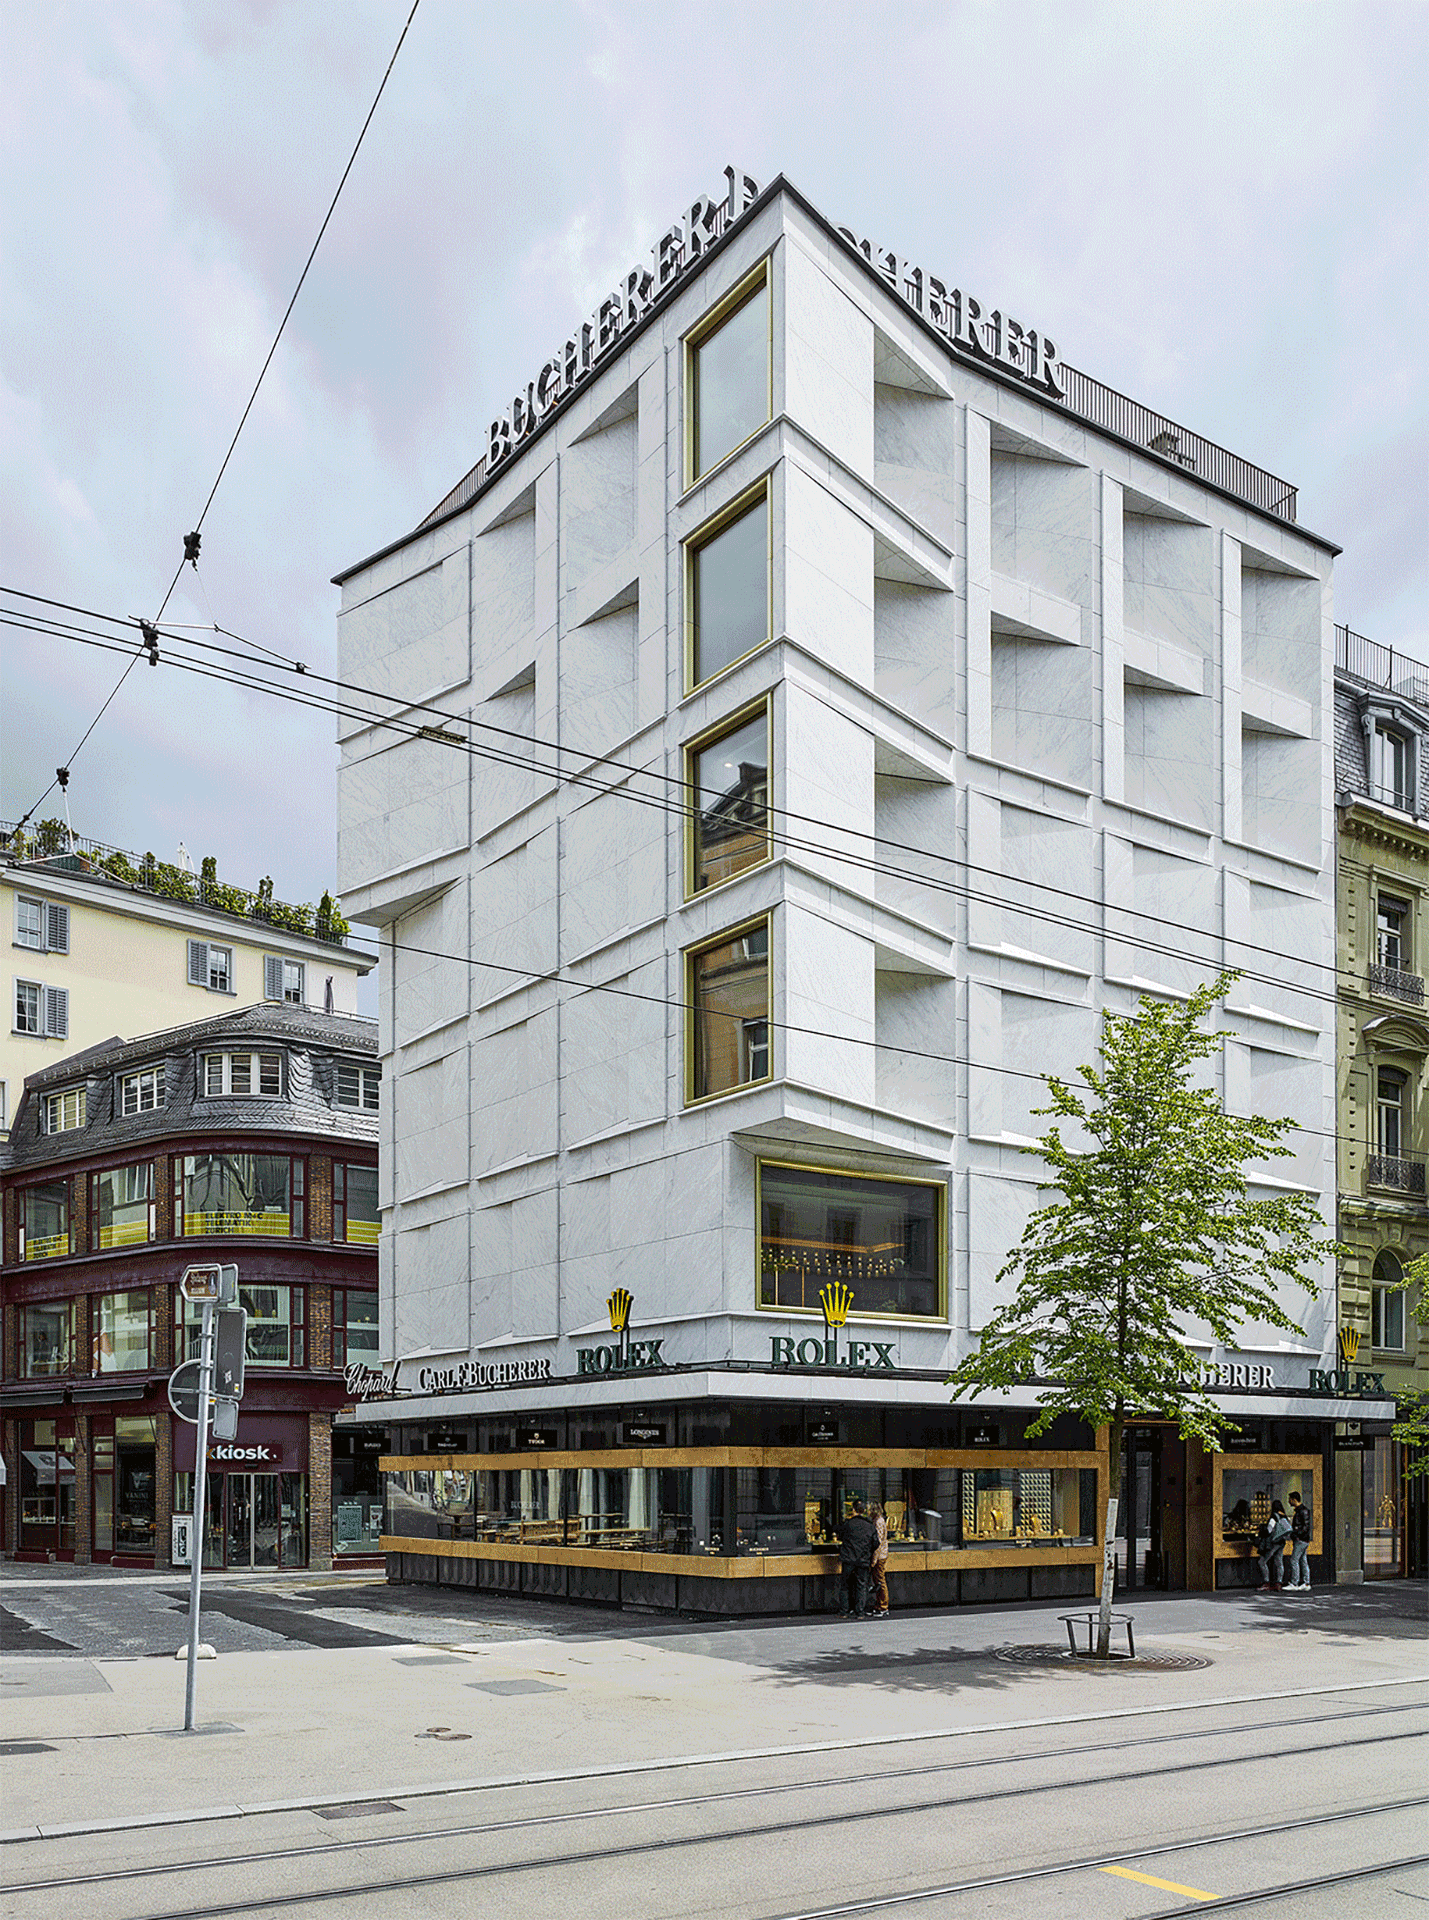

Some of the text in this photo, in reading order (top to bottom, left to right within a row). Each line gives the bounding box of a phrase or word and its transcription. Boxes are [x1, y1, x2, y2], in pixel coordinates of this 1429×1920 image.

[485, 193, 717, 476] BUCHERER
[576, 1339, 667, 1375] ROLEX
[769, 1336, 896, 1369] ROLEX
[343, 1360, 407, 1402] Chopard
[418, 1366, 457, 1391] CARL
[469, 1359, 552, 1386] BUCHERER
[1308, 1369, 1387, 1394] ROLEX
[216, 1444, 270, 1460] kiosk
